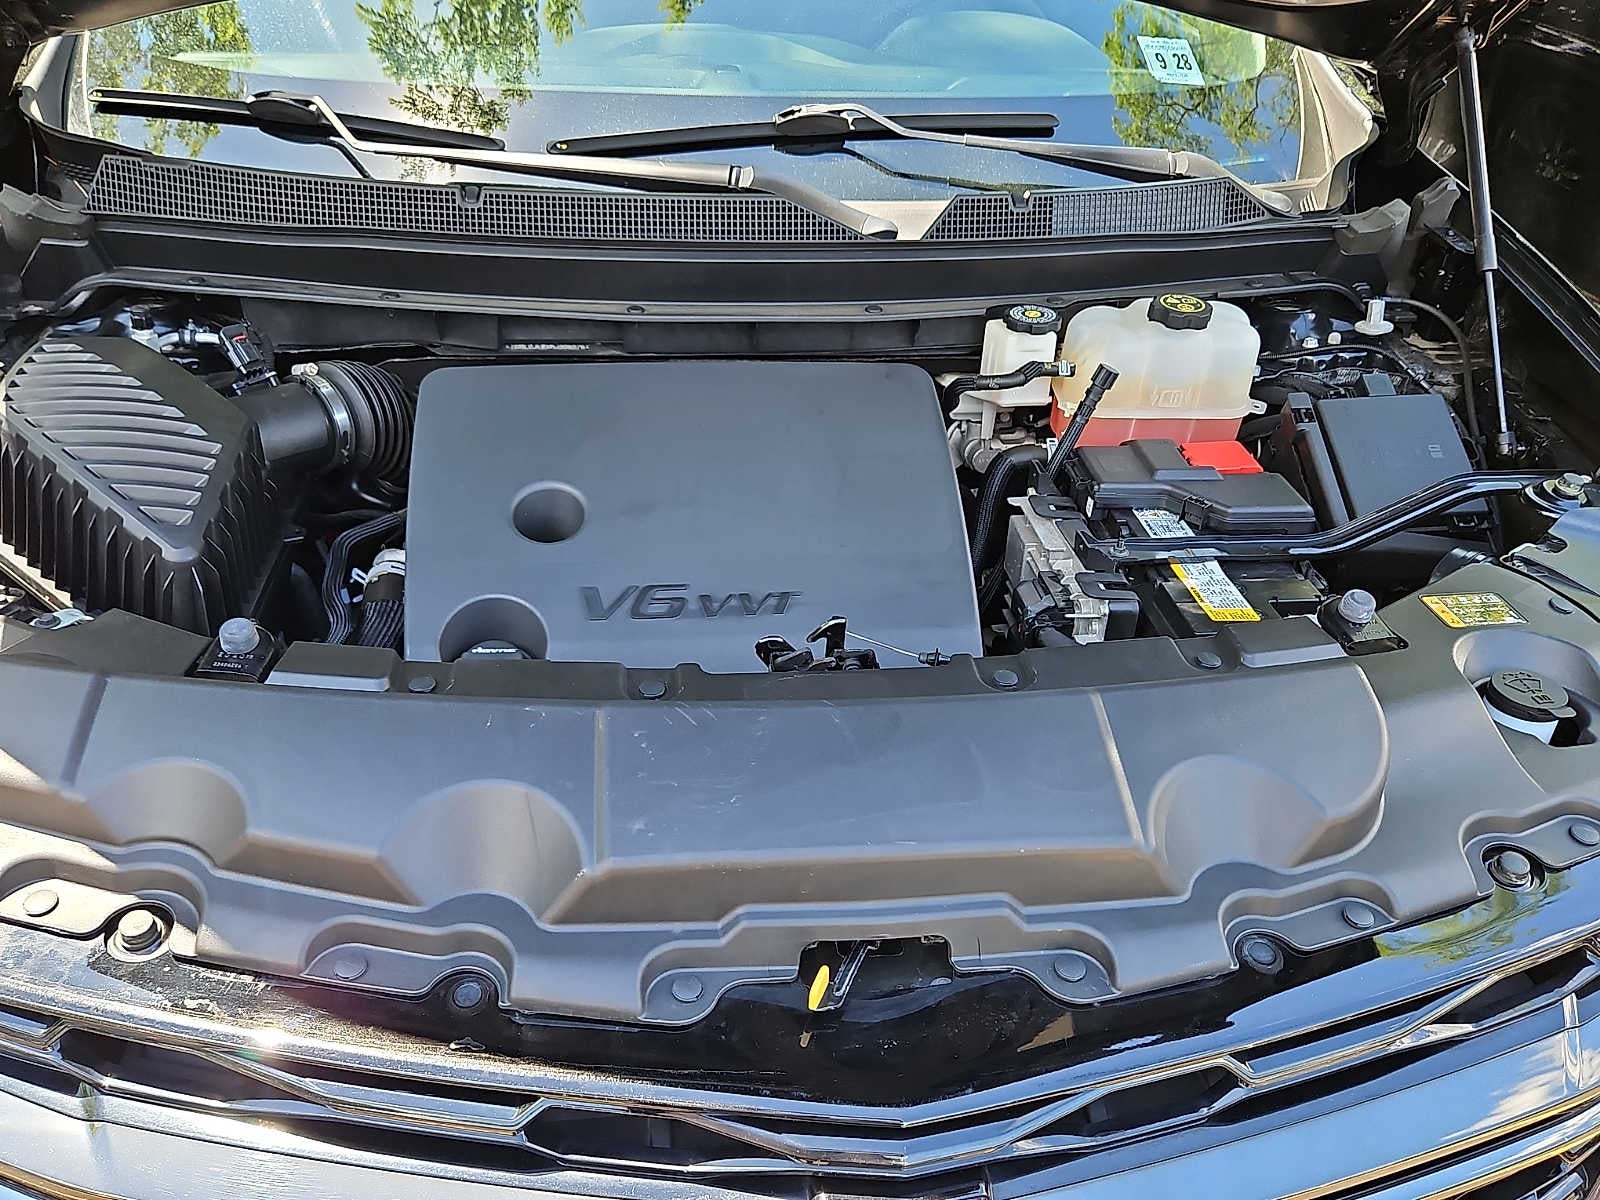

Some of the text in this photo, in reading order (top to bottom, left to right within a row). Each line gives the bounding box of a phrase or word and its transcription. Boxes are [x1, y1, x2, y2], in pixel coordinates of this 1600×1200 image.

[1154, 52, 1193, 71] 9 28
[578, 583, 803, 622] V6 VVT
